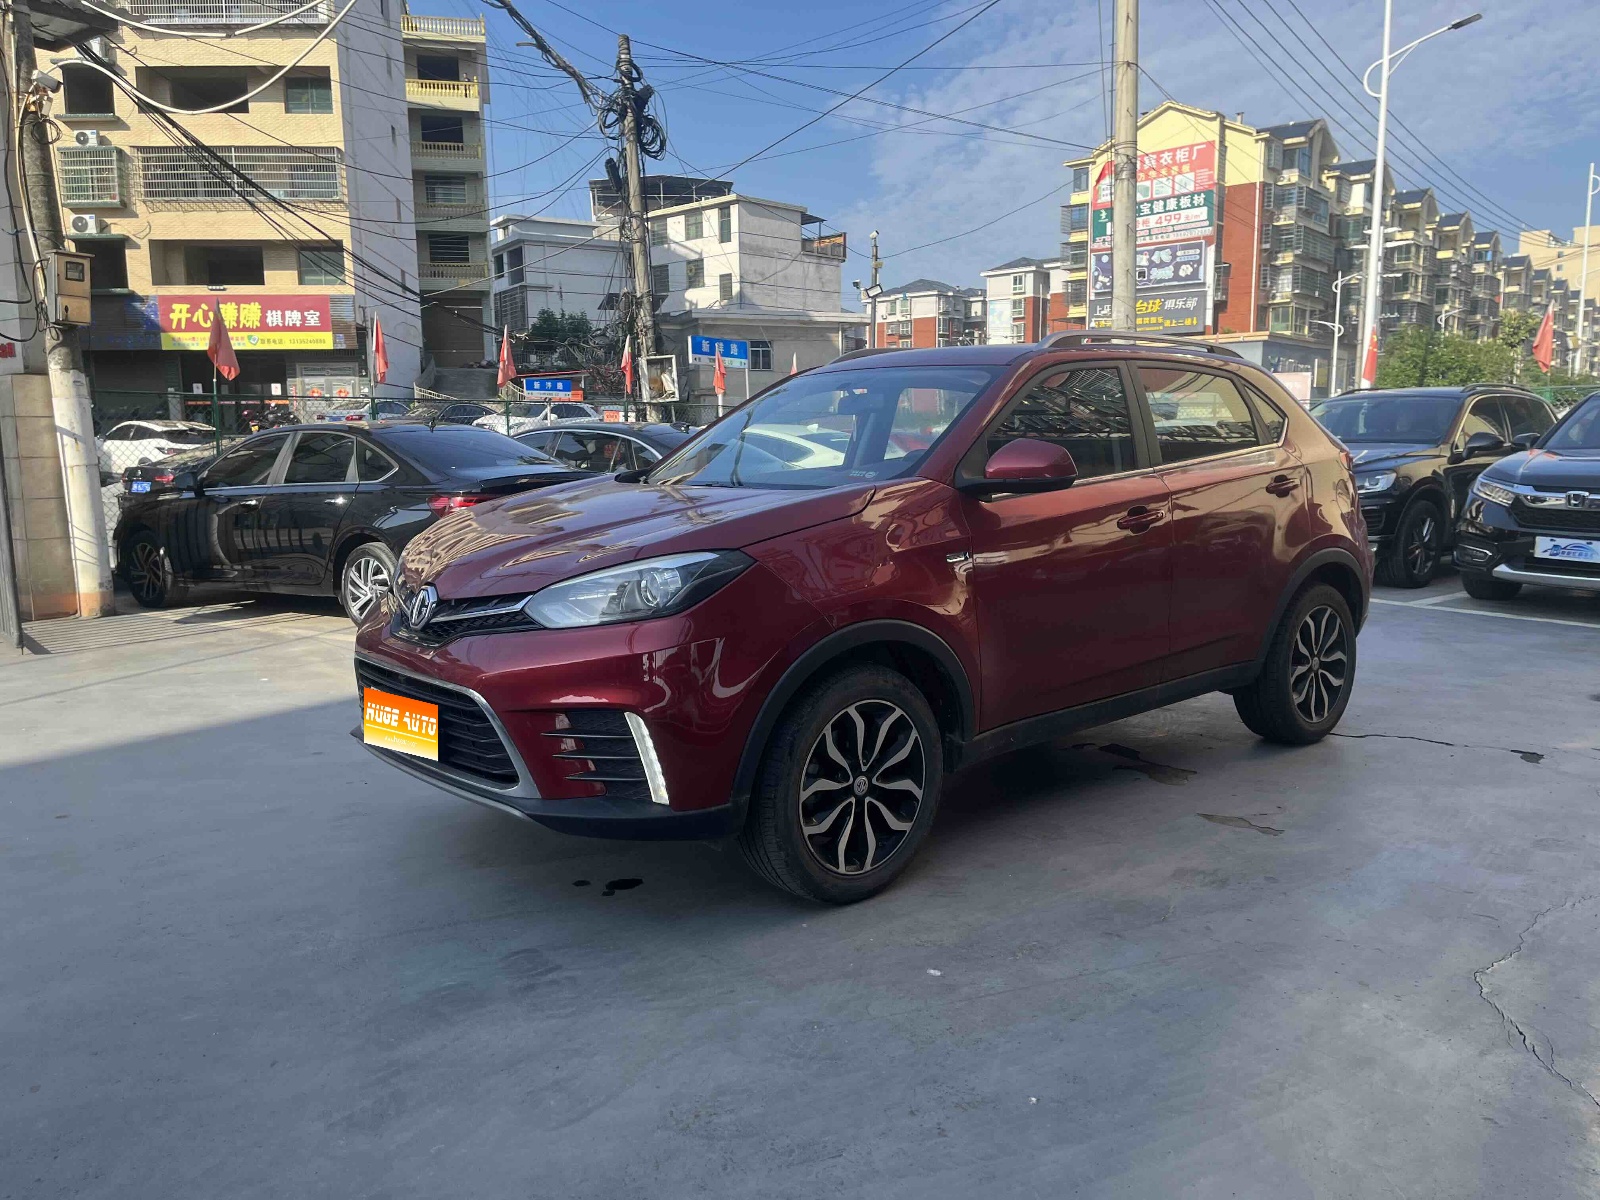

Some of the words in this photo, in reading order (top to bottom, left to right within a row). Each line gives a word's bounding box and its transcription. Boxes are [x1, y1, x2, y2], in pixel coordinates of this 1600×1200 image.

[1136, 193, 1205, 216] 宝健康板材
[1155, 213, 1181, 226] 499
[1164, 297, 1198, 311] 俱乐部
[265, 309, 321, 327] 棋牌室
